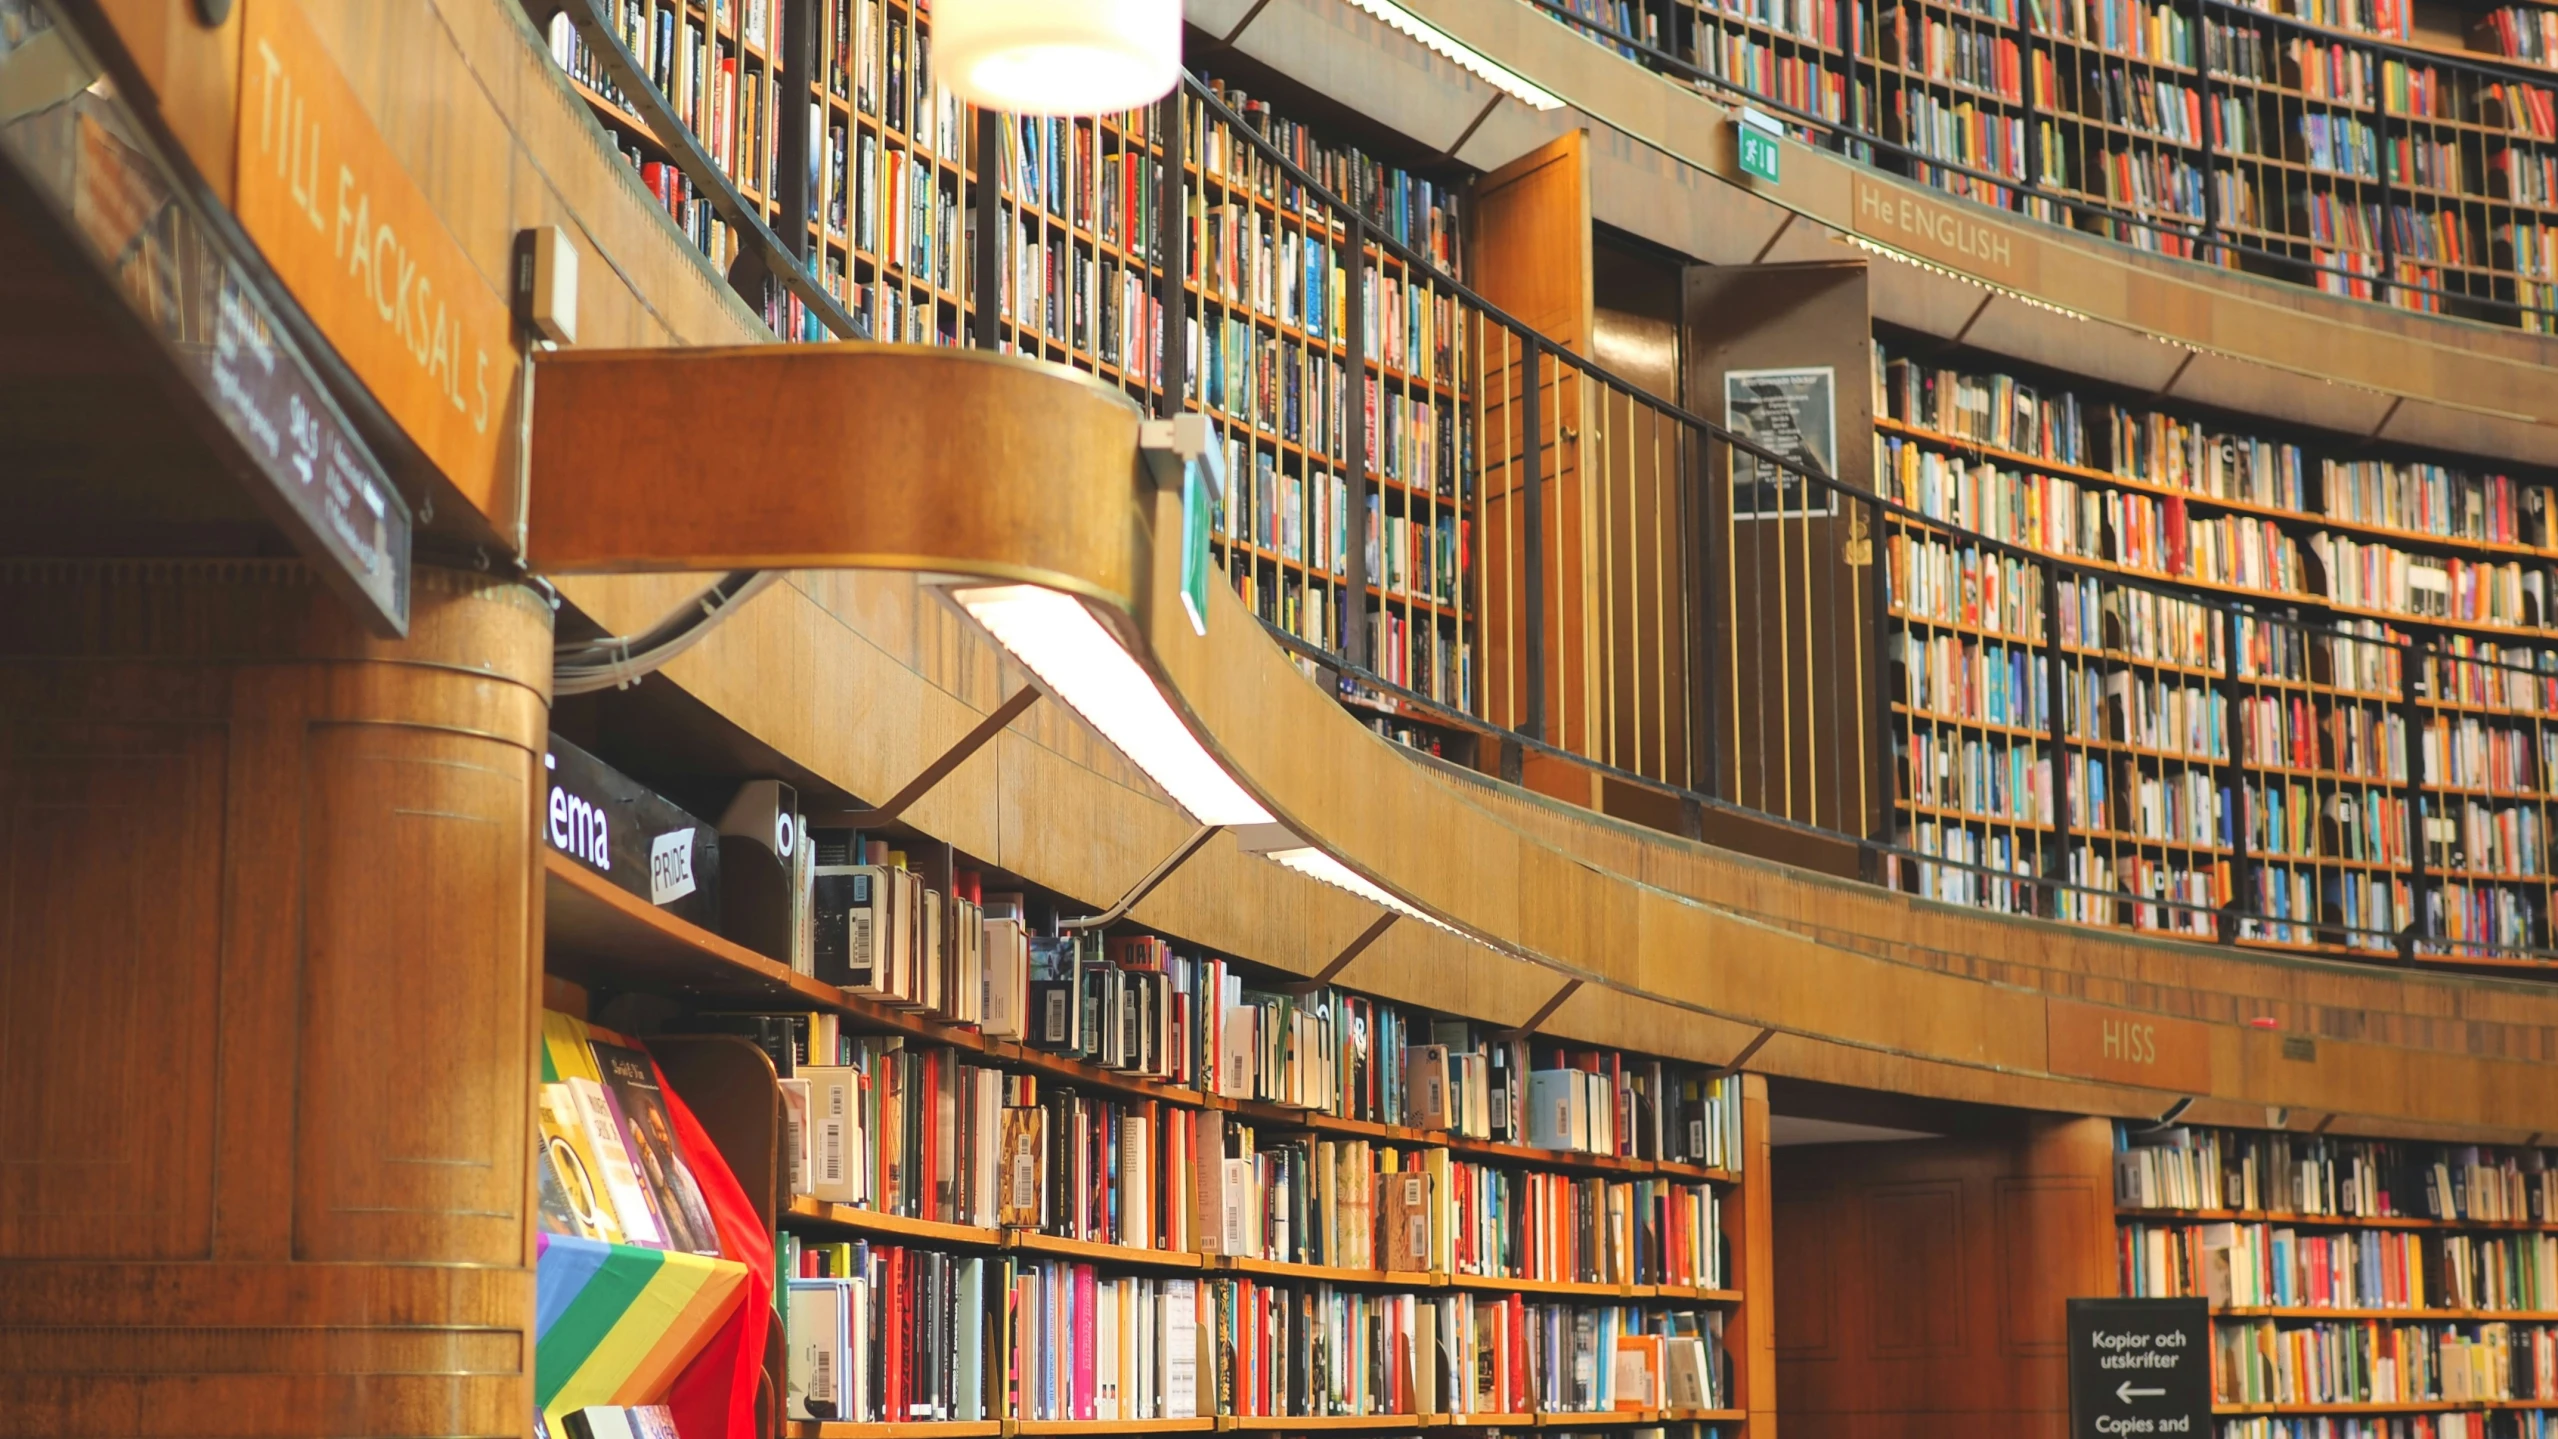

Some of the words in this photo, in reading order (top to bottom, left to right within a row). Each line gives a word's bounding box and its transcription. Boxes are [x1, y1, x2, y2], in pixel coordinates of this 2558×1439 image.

[258, 38, 326, 230] TILL
[334, 164, 466, 414] FACKSAL
[473, 350, 489, 433] 5
[1861, 185, 1893, 225] He
[1900, 202, 2010, 267] ENGLISH
[544, 752, 611, 871] ema
[653, 843, 690, 892] PRIDE
[776, 812, 794, 858] O
[2103, 1019, 2155, 1064] HISS
[2092, 1330, 2150, 1352] Kopior
[2155, 1329, 2186, 1348] och
[2101, 1351, 2179, 1369] utskrifter
[2095, 1415, 2154, 1438] Copies
[2159, 1414, 2189, 1432] and
